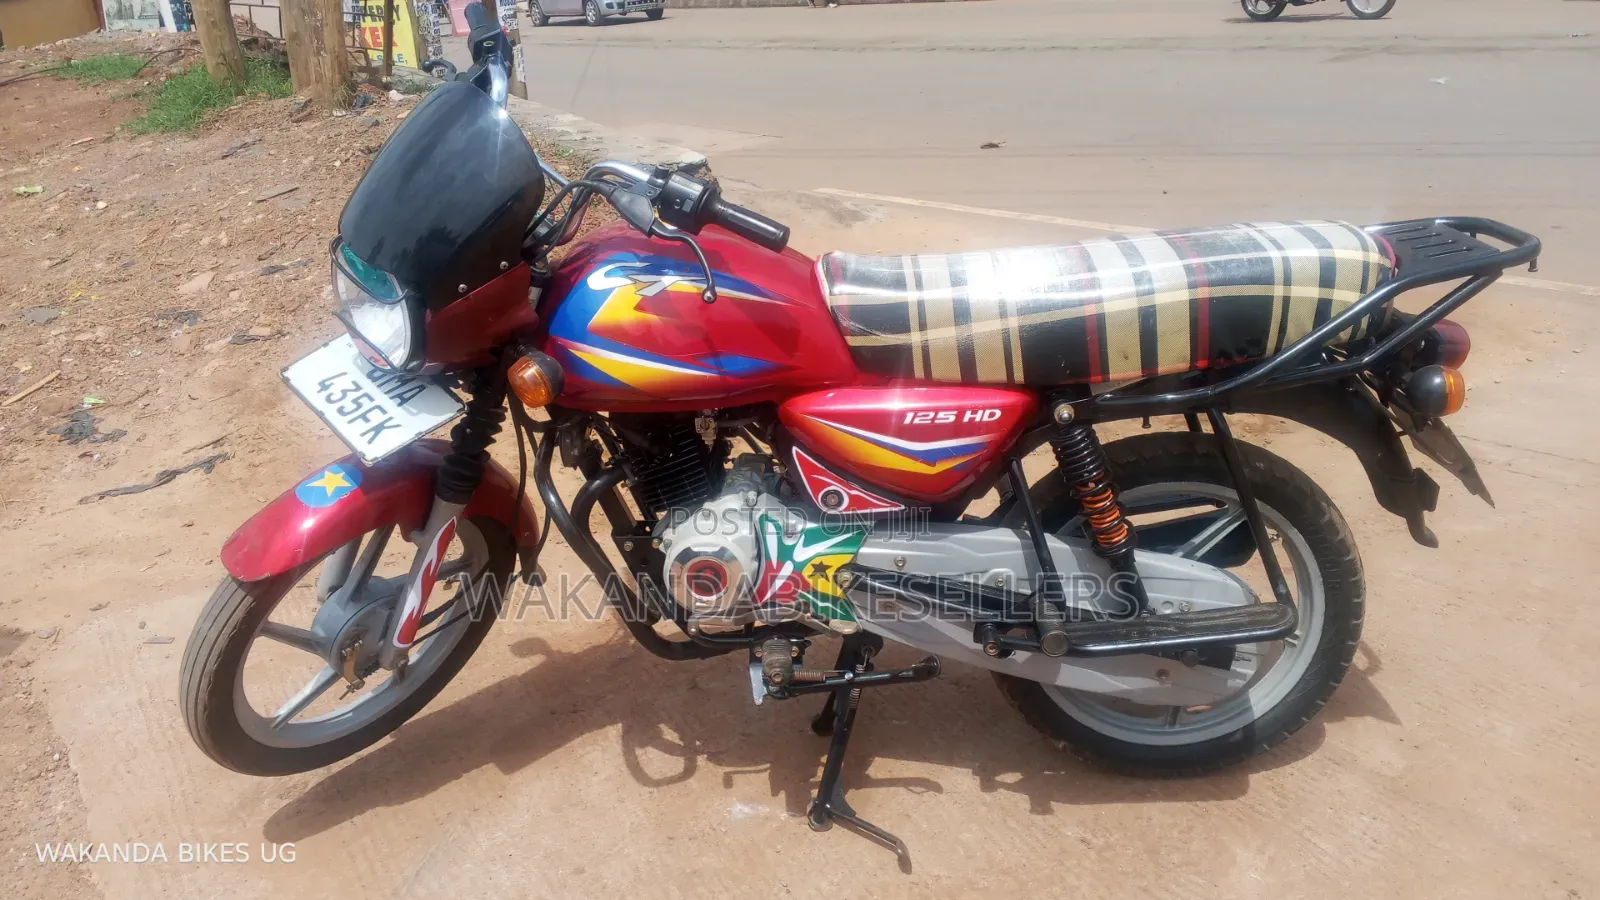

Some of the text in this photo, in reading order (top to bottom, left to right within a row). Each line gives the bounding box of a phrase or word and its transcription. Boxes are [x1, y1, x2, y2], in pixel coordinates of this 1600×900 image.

[360, 5, 401, 25] PERY
[360, 26, 398, 48] KE
[316, 371, 402, 445] 435FK
[903, 408, 1002, 425] 125 HD
